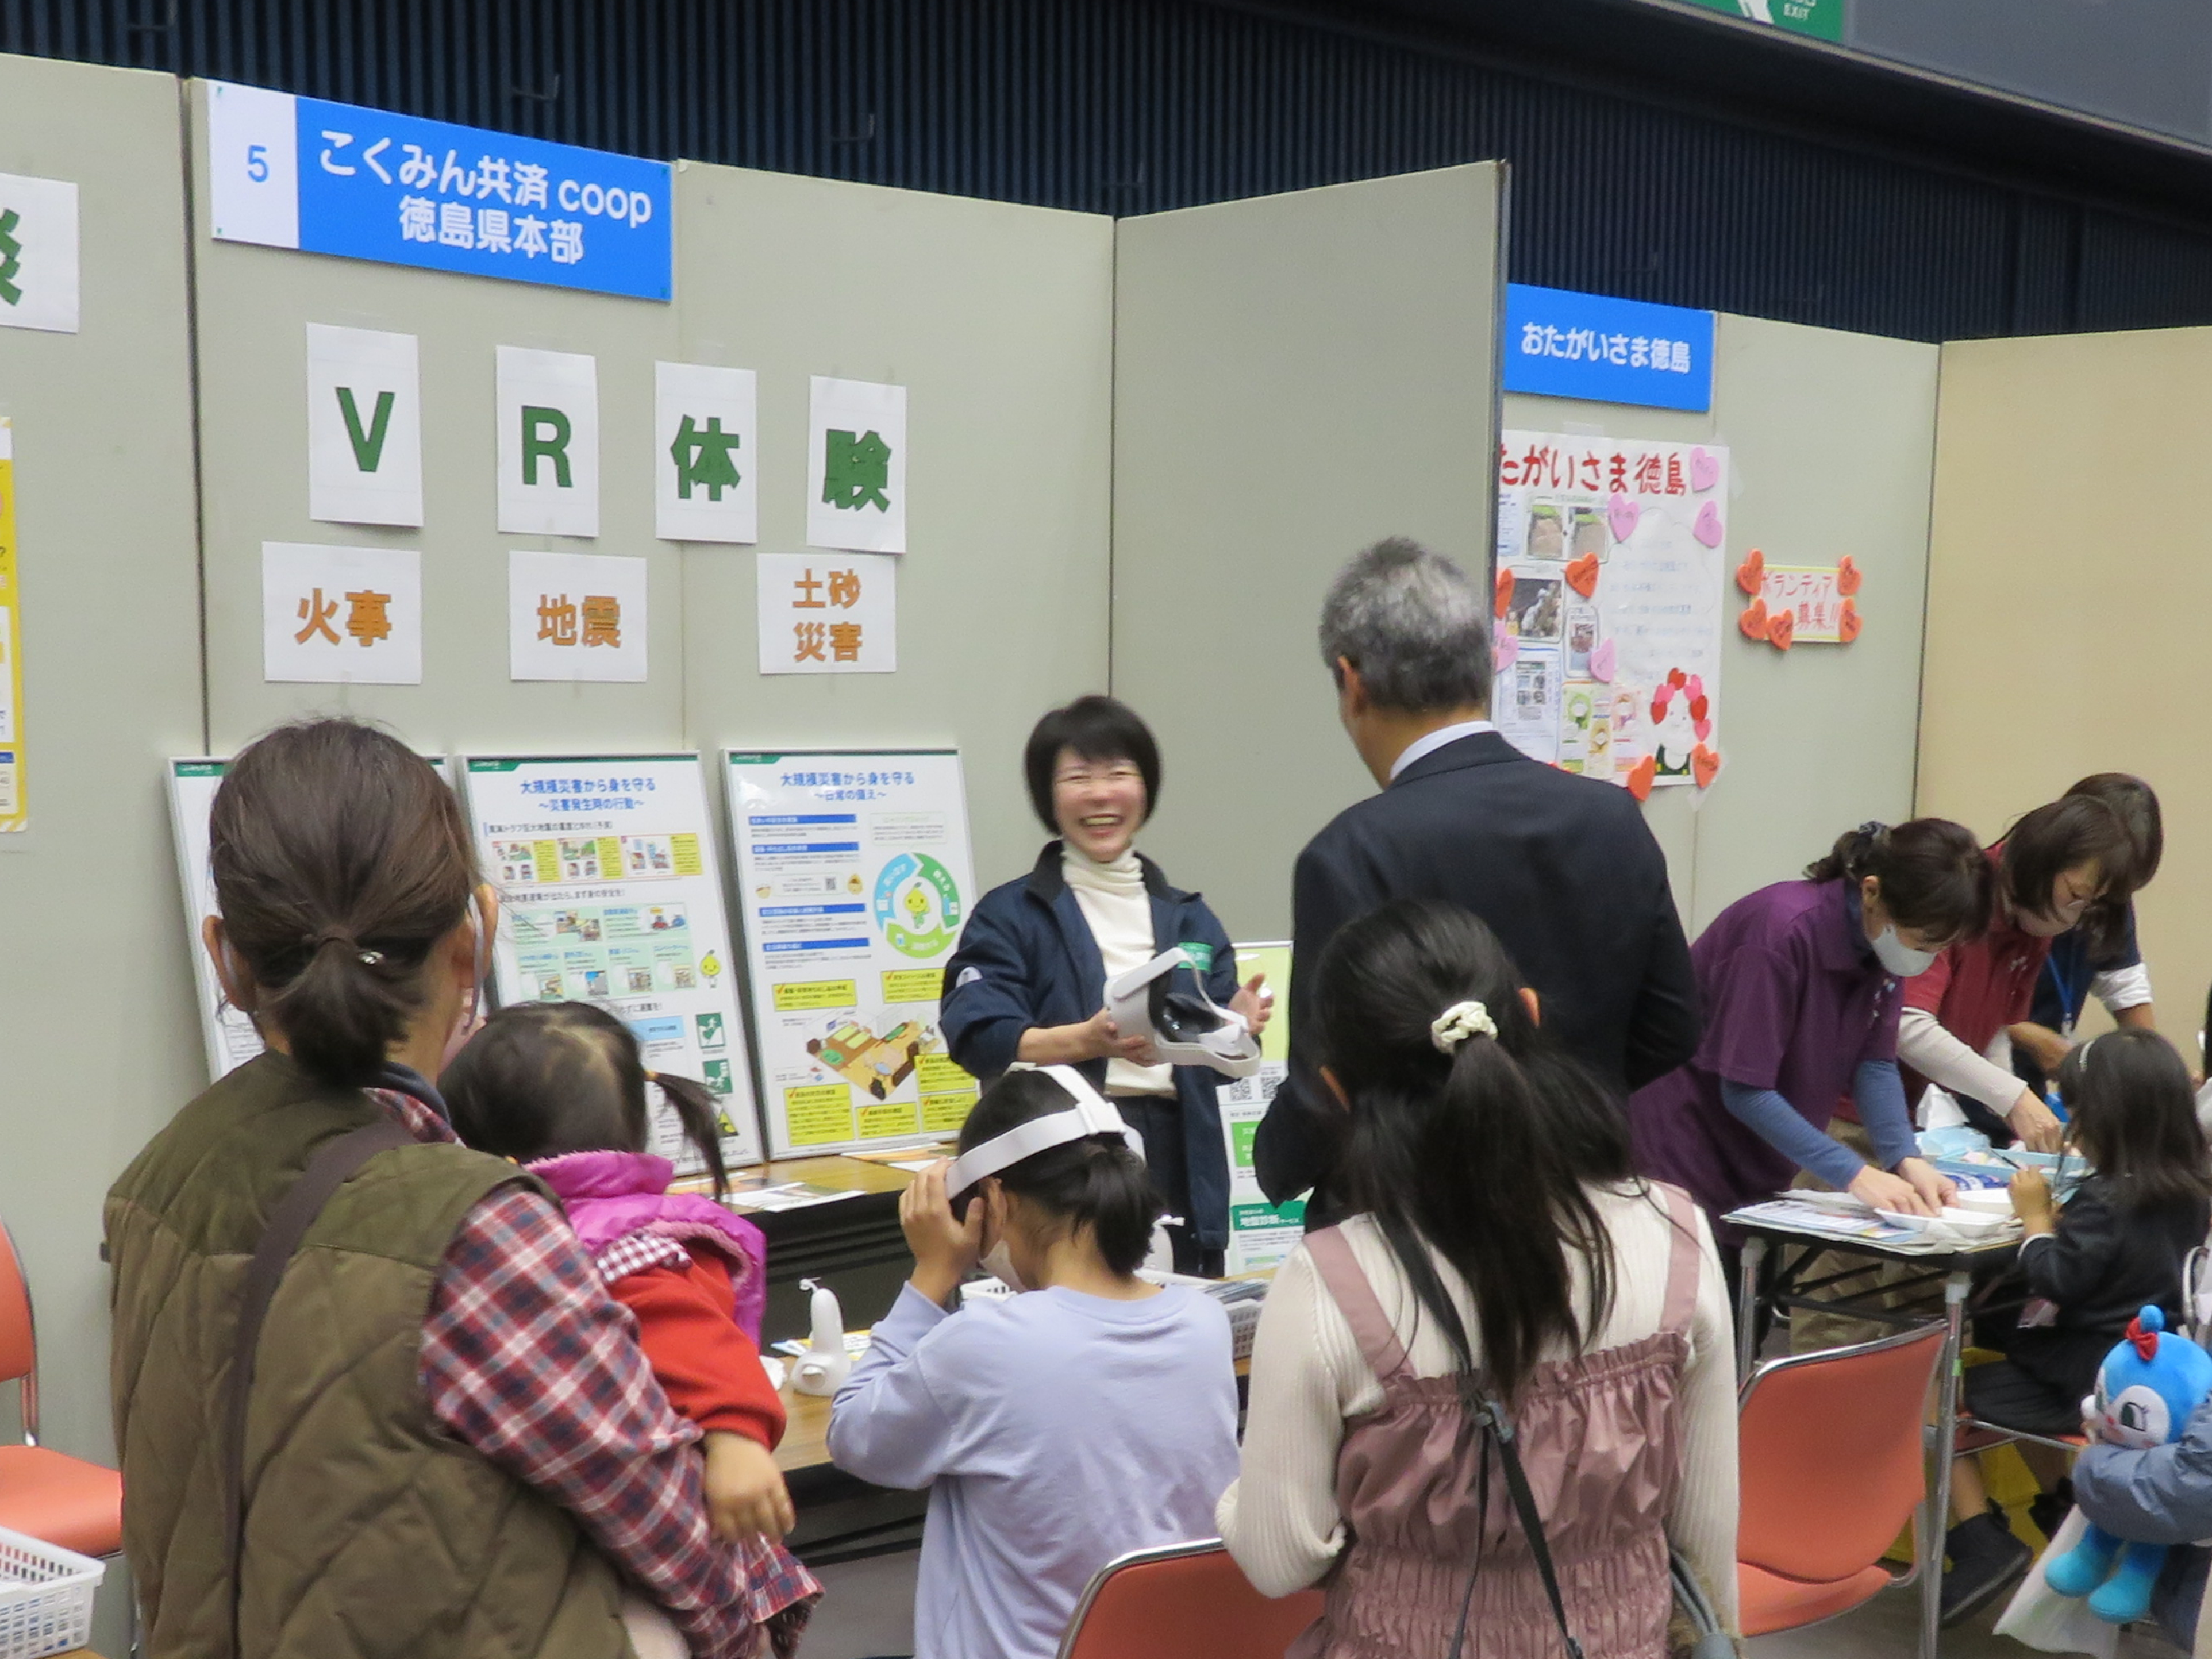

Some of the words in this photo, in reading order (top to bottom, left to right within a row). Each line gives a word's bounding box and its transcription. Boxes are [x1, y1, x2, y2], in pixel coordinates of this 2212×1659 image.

[1783, 3, 1810, 21] EXIT
[247, 145, 269, 183] 5
[320, 130, 548, 209] こくみん共済
[557, 179, 652, 229] coop
[398, 194, 584, 264] 徳島県本部
[1521, 322, 1691, 374] おたがいさま徳島
[792, 568, 863, 610] 土砂
[293, 587, 393, 648] 火事
[537, 594, 621, 650] 地震
[792, 621, 863, 663] 災害
